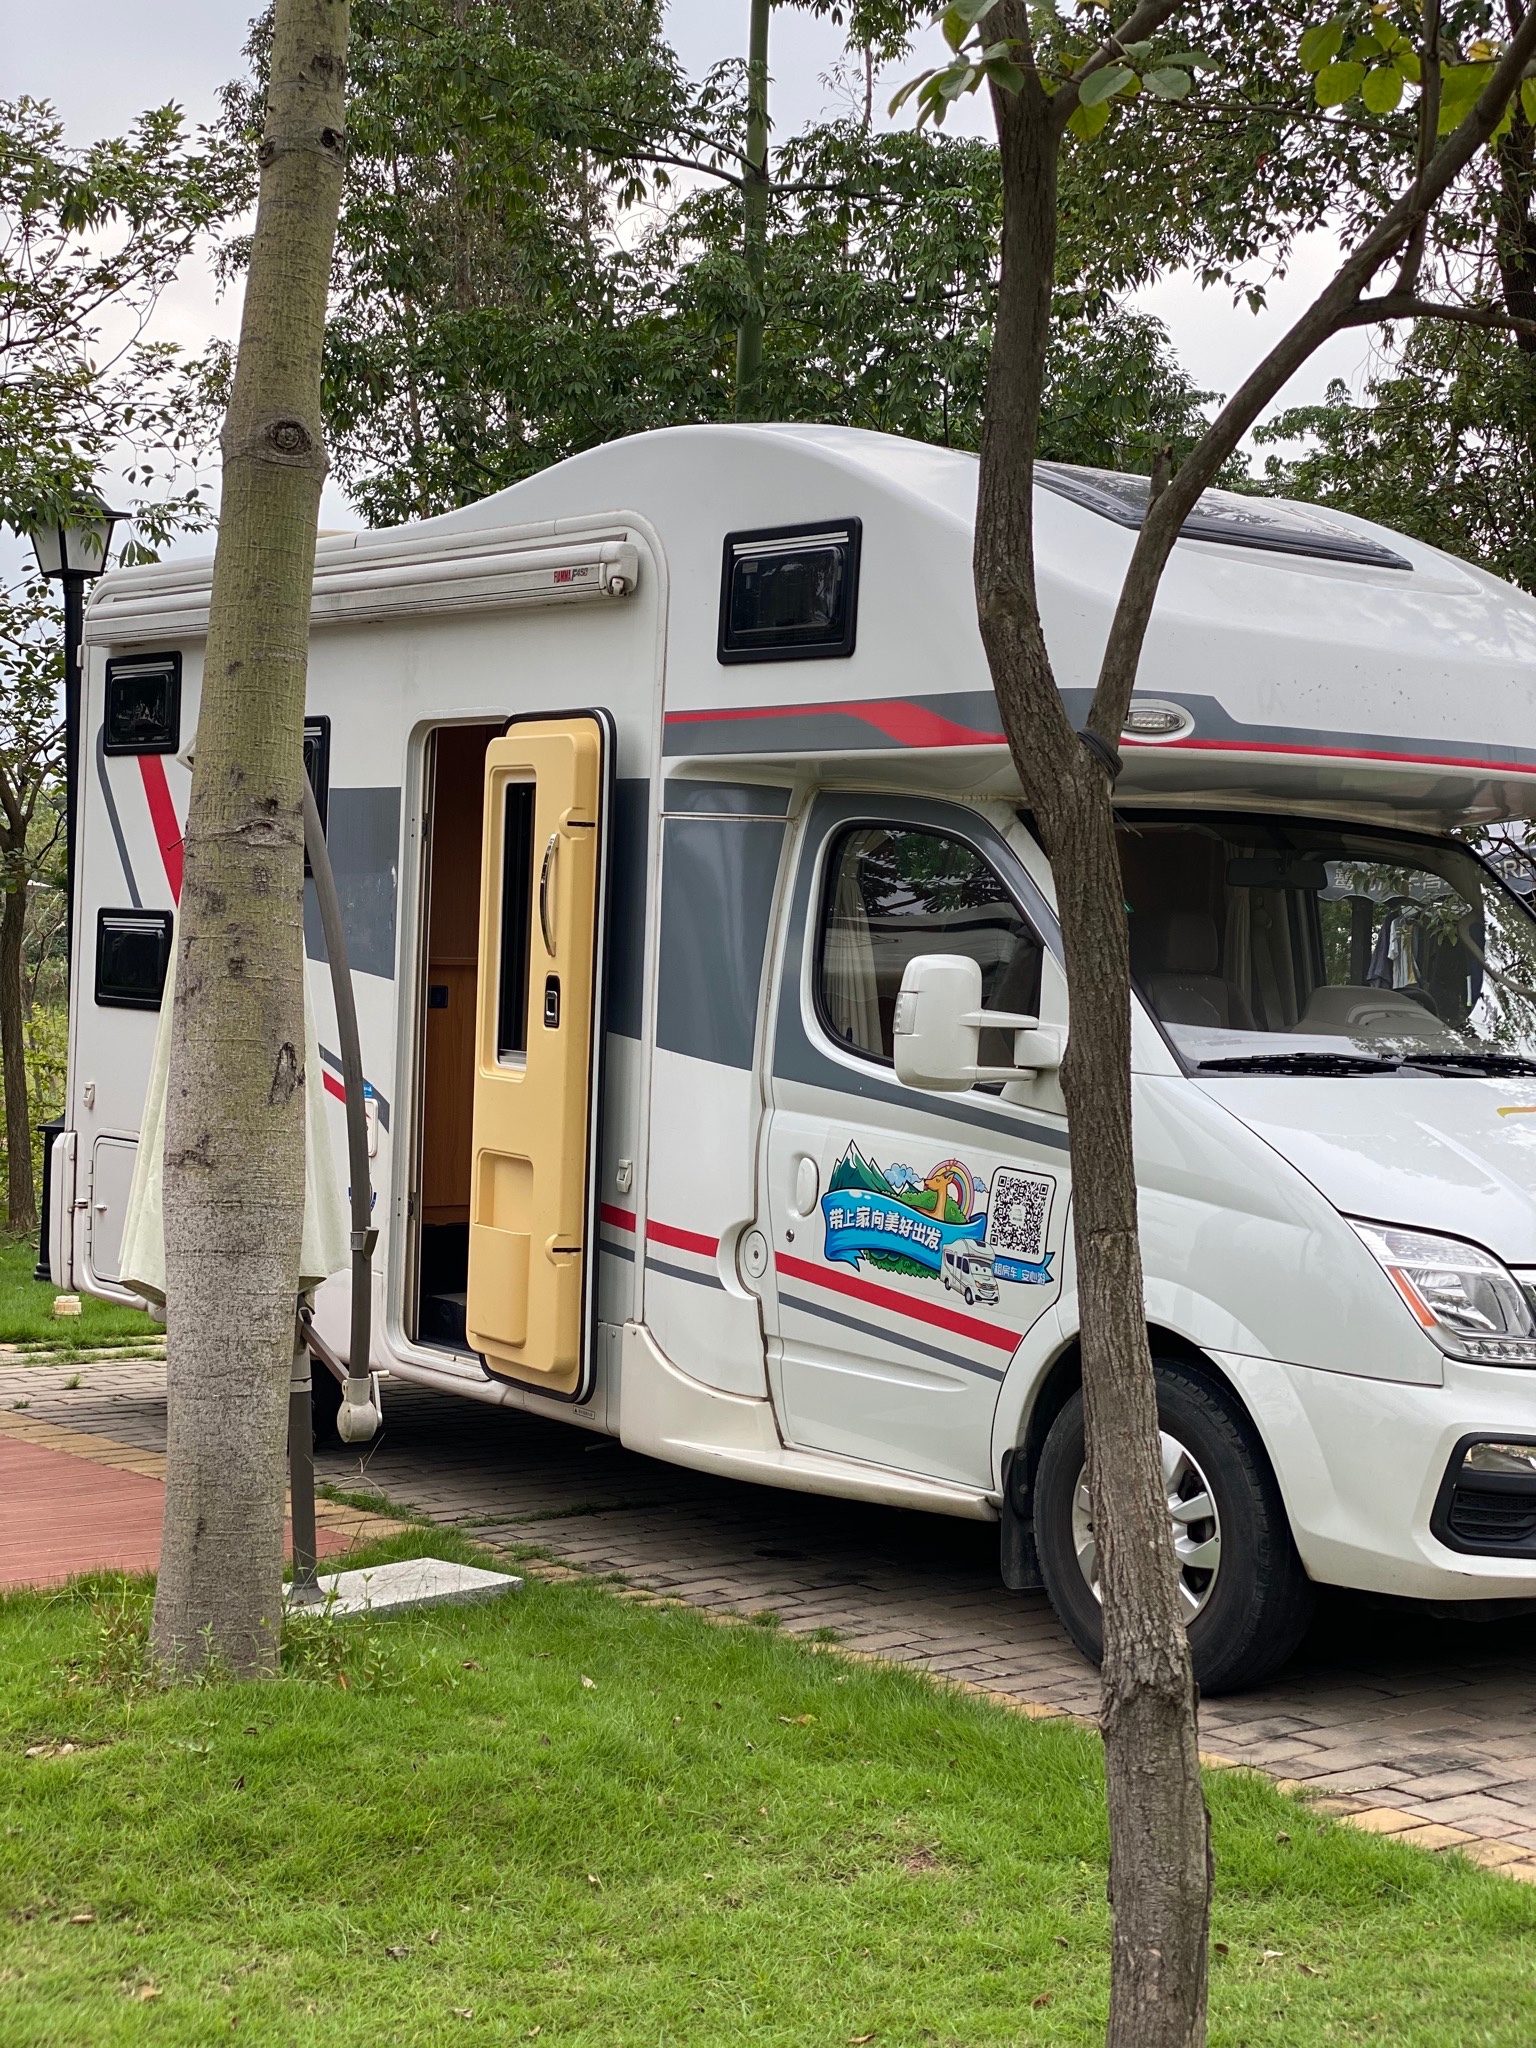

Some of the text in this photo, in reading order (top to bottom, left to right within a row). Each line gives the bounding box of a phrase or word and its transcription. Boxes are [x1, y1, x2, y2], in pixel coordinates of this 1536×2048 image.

[829, 1206, 942, 1251] 带上家向美好出发
[994, 1262, 1018, 1279] 租房车
